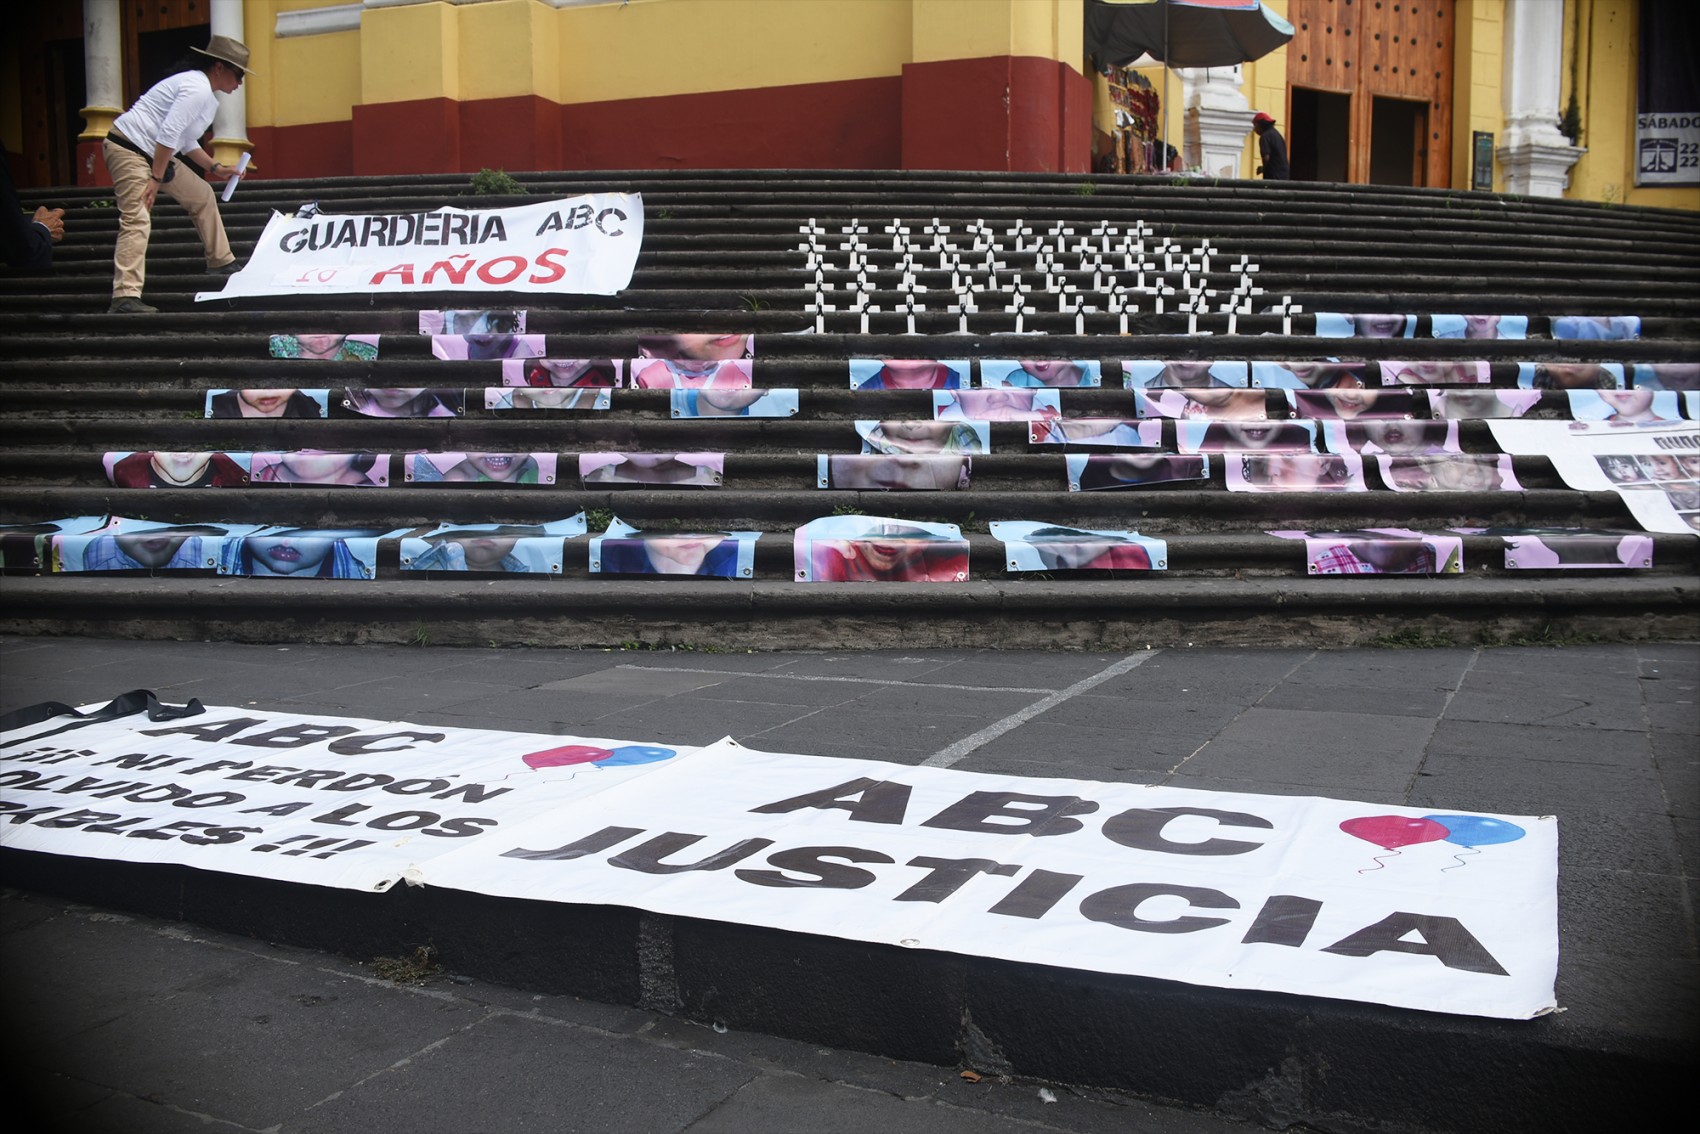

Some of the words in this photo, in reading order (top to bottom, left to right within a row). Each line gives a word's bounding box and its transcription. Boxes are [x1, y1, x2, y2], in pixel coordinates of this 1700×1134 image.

[1638, 115, 1700, 129] SÁBADO
[279, 212, 507, 254] GUARDERIA
[536, 204, 628, 237] ABC
[368, 247, 569, 285] AÑOS
[138, 717, 446, 756] ABC
[90, 753, 194, 771] NI
[178, 760, 515, 804] PERDÓN
[0, 770, 246, 809] OLVIDO
[237, 802, 314, 816] A
[310, 802, 499, 838] LOS
[747, 777, 1274, 856] ABC
[498, 825, 1512, 977] JUSTICIA
